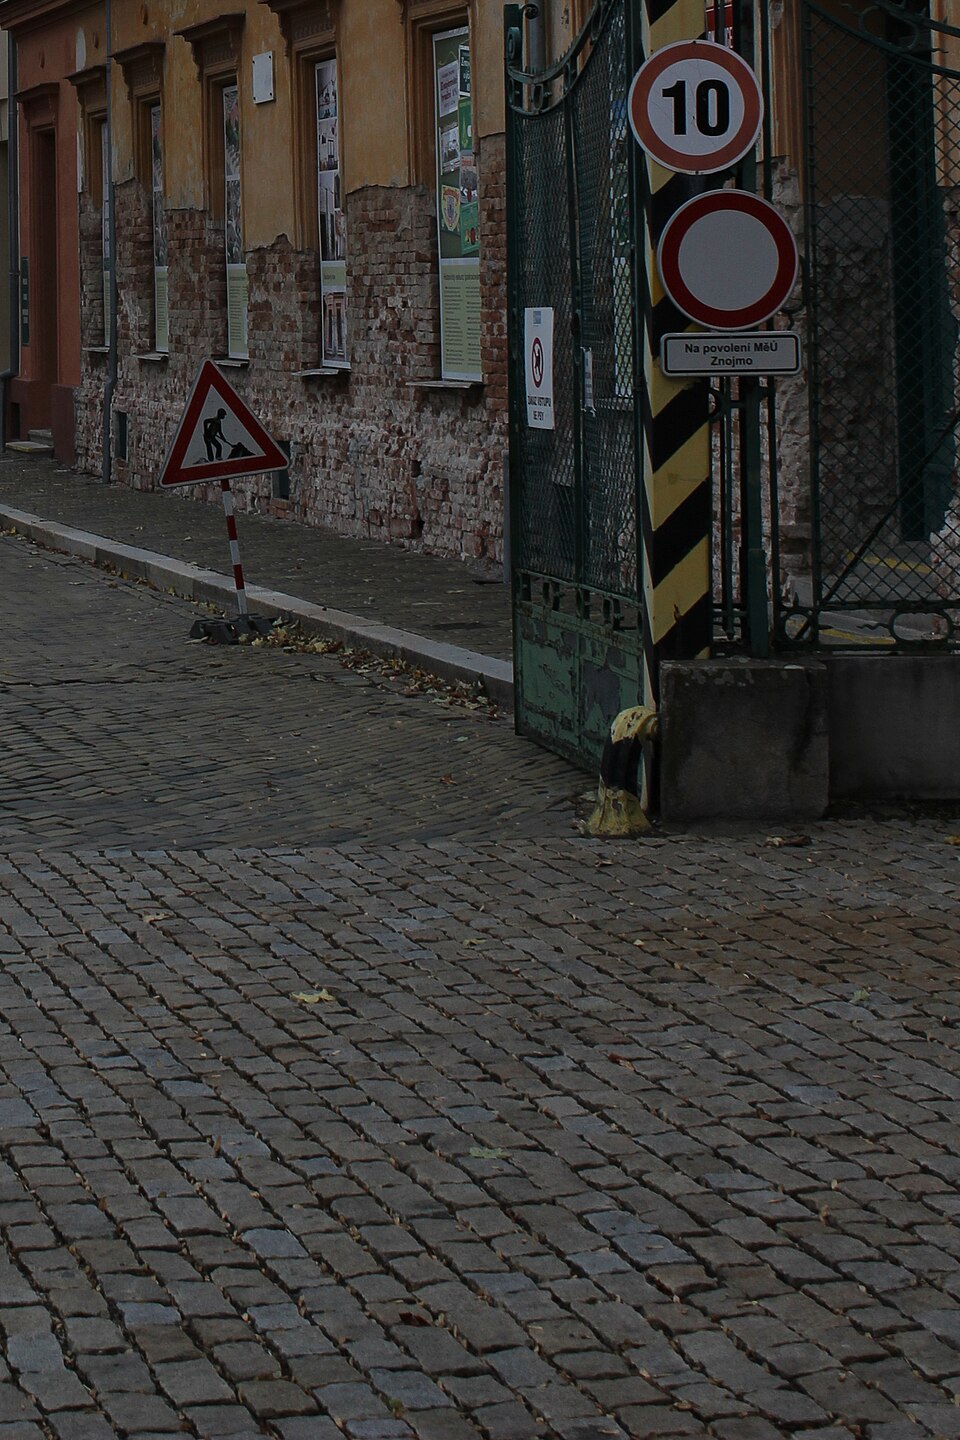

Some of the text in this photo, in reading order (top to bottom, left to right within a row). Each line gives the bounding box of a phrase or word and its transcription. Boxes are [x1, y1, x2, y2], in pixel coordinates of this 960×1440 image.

[662, 79, 730, 137] 10
[685, 343, 700, 353] Na
[703, 343, 751, 355] povolení
[710, 356, 753, 367] Znojmo
